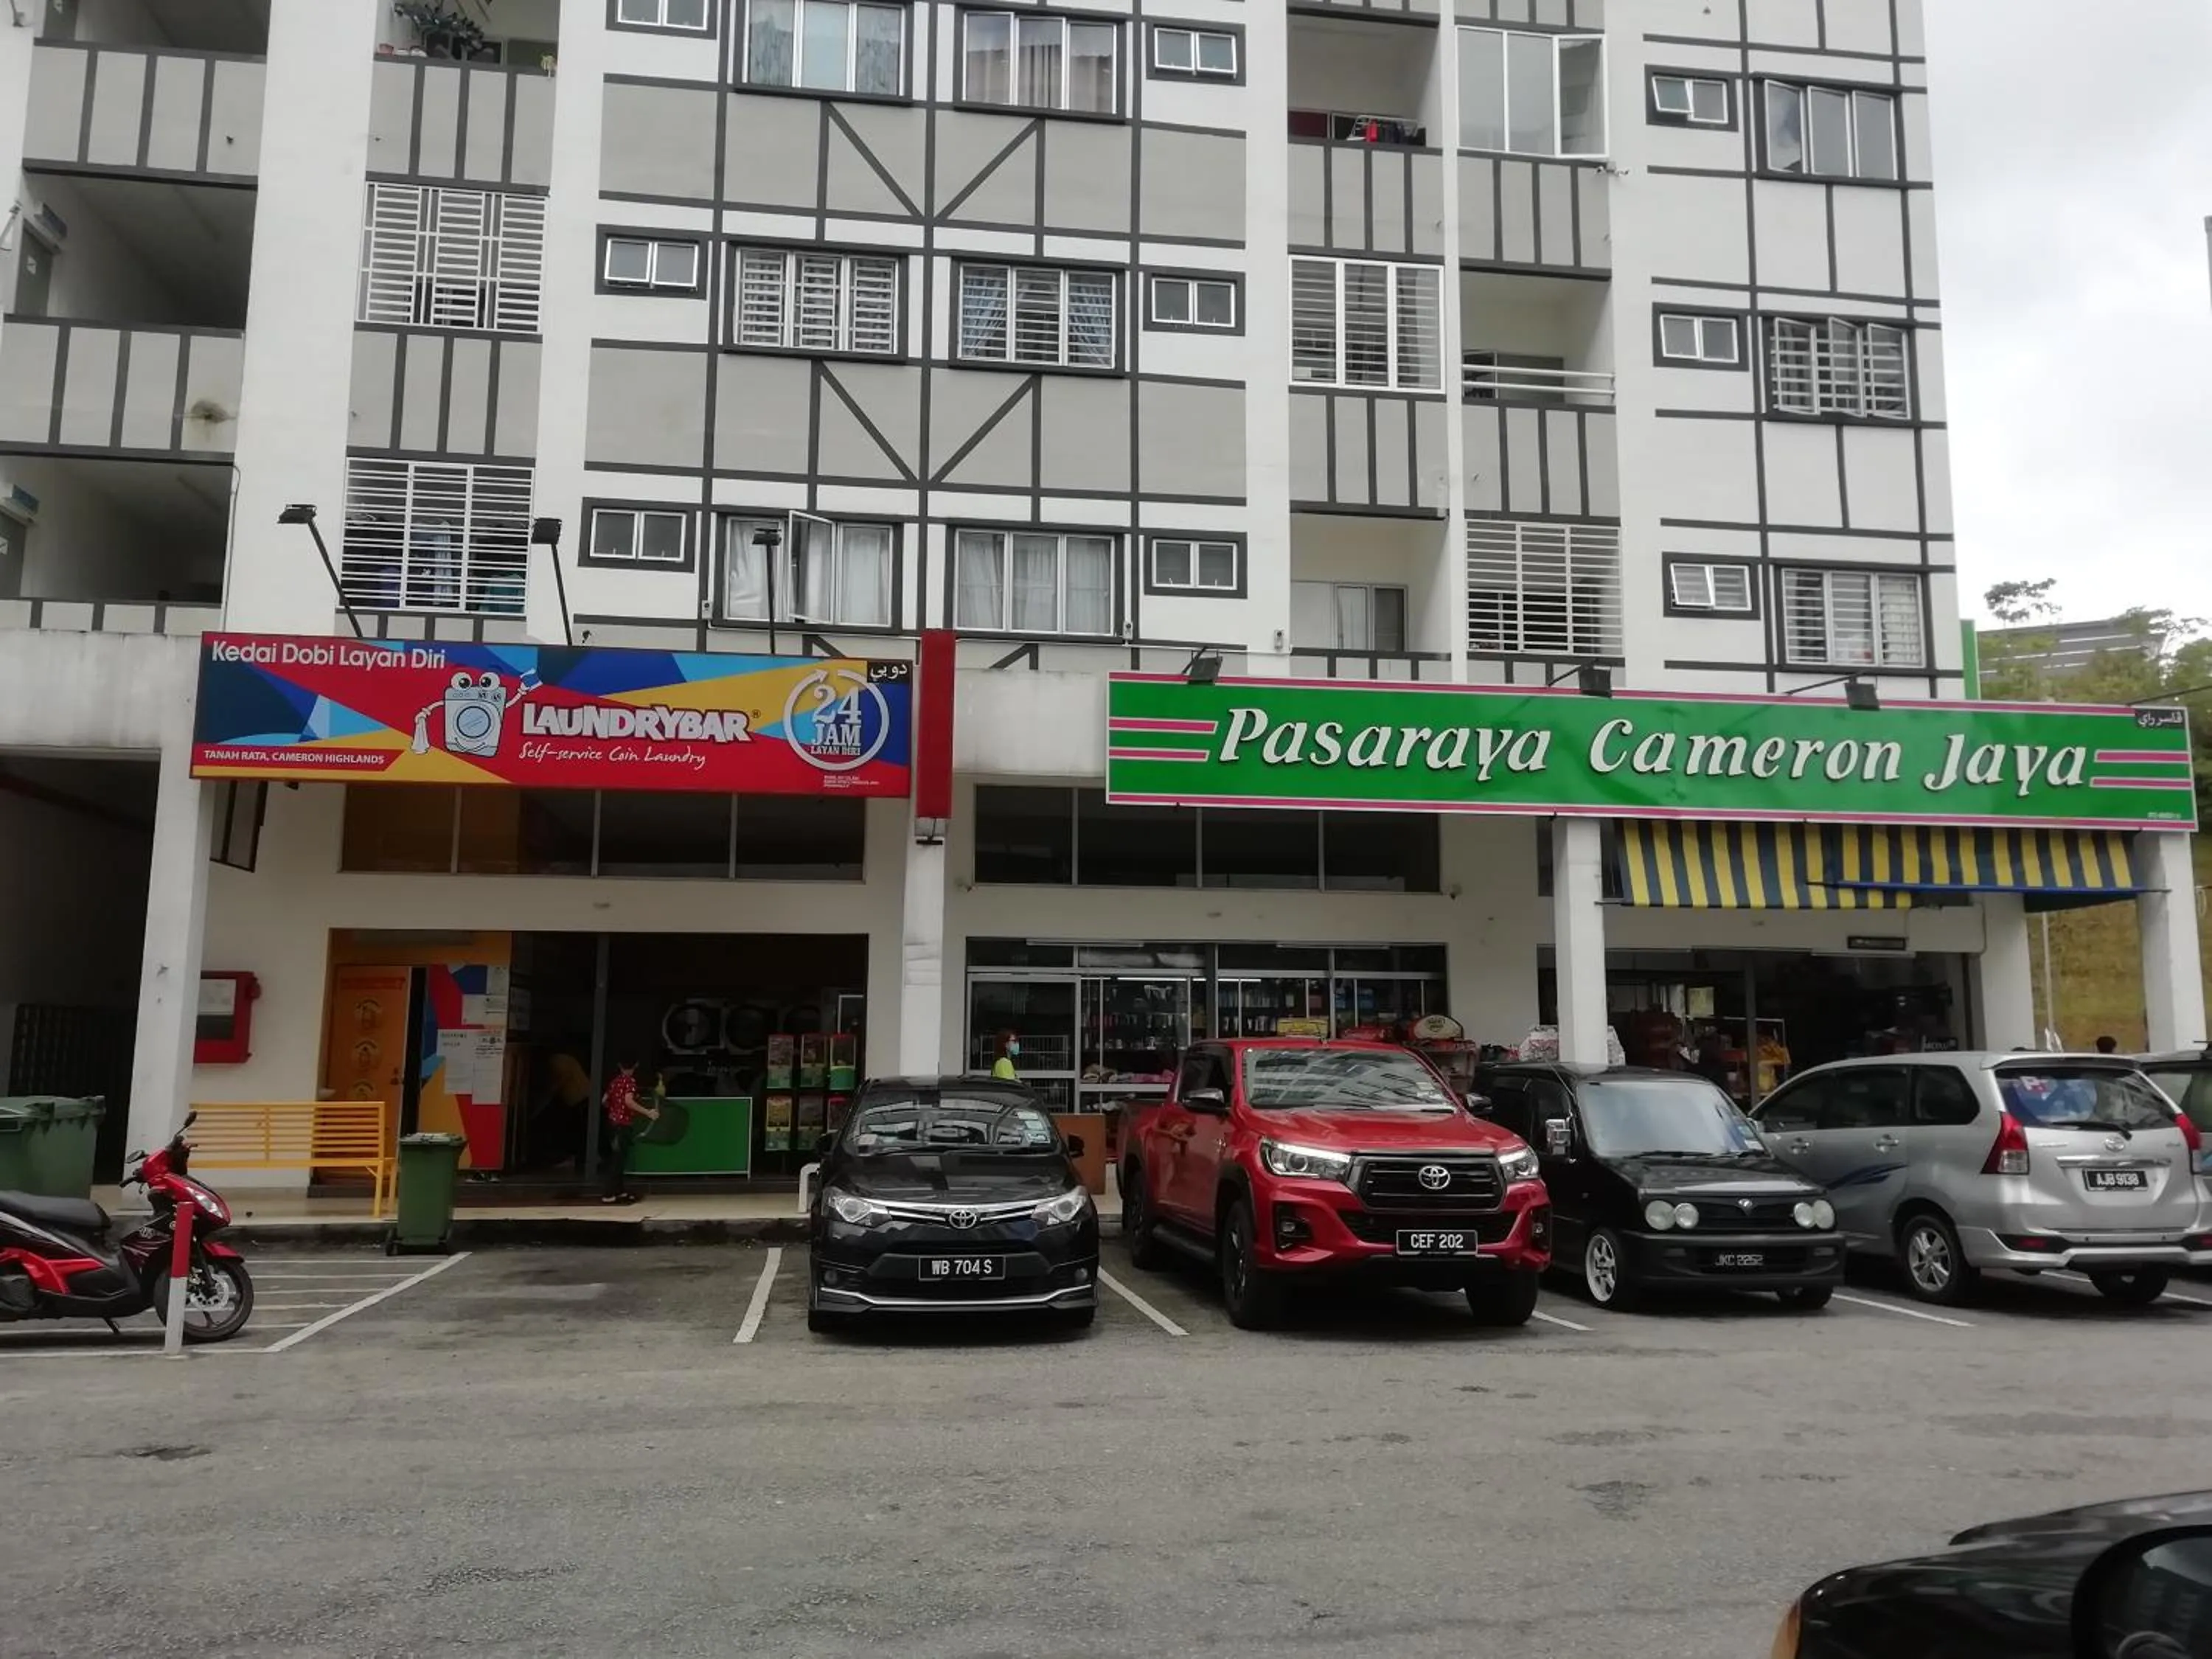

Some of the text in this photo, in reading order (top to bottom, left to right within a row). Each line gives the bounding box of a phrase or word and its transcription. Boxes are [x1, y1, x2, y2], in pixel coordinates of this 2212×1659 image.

[212, 639, 445, 672] Kedai Dobi Layan Diri
[812, 684, 862, 723] 24
[522, 702, 752, 742] LAUNDRYBAR
[811, 723, 862, 746] JAM
[204, 750, 240, 760] TANAH
[271, 752, 323, 762] CAMERON
[325, 754, 384, 765] HIGHLANDS
[518, 741, 706, 771] Self-service Coin Laundry
[810, 745, 839, 756] LAYAN
[1219, 707, 2087, 797] Pasaraya Cameron Jaya
[1410, 1234, 1464, 1249] CEF 202
[931, 1258, 992, 1275] WB 704 S
